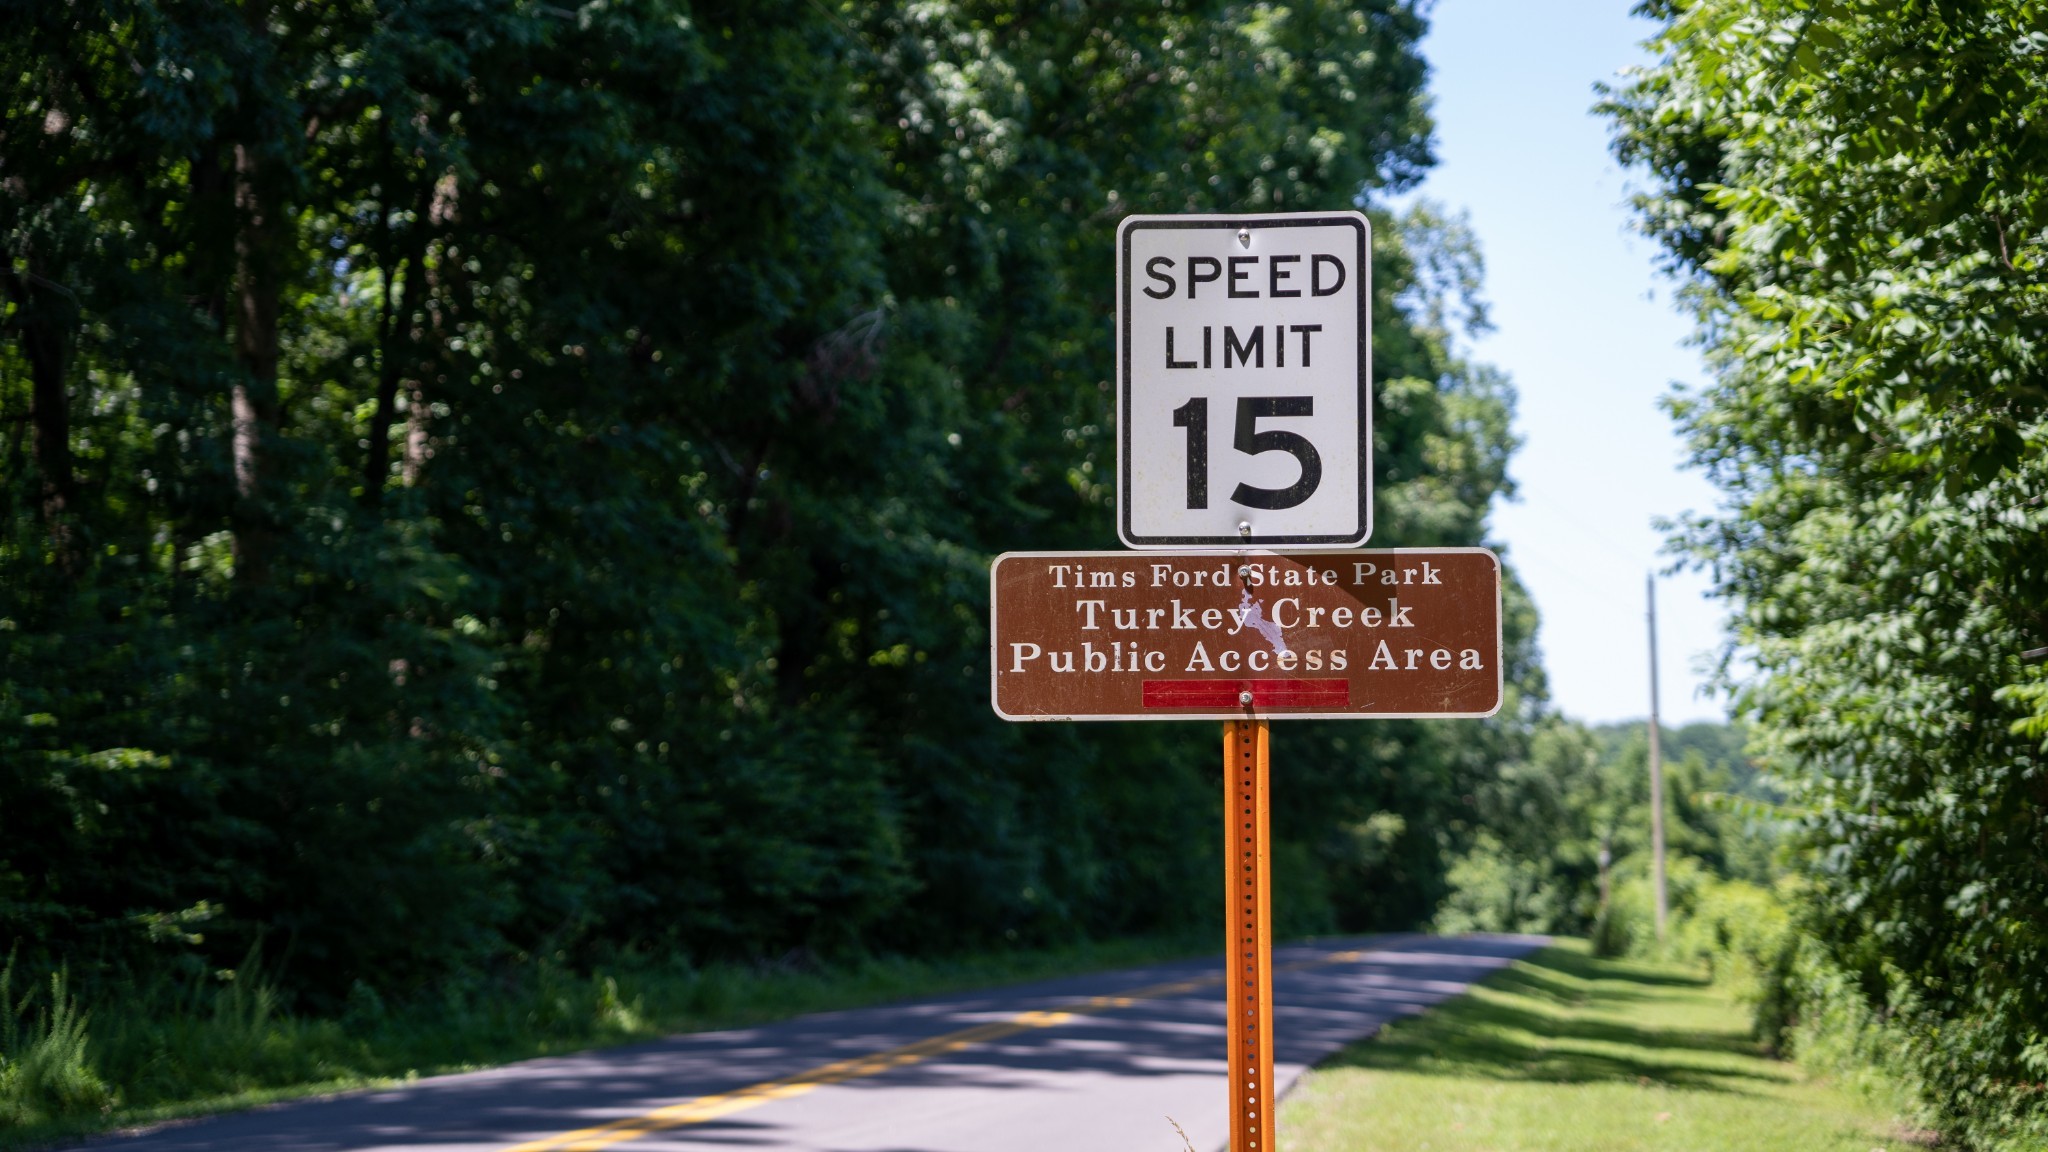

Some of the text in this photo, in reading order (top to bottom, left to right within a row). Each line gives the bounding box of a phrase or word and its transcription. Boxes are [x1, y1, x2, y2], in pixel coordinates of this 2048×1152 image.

[1142, 253, 1346, 299] SPEED
[1165, 324, 1322, 369] LIMIT
[1172, 395, 1322, 510] 15
[1048, 561, 1442, 588] Tims Ford State Park
[1076, 597, 1415, 636] Turkey Creek
[1009, 639, 1484, 673] Public Access Area
